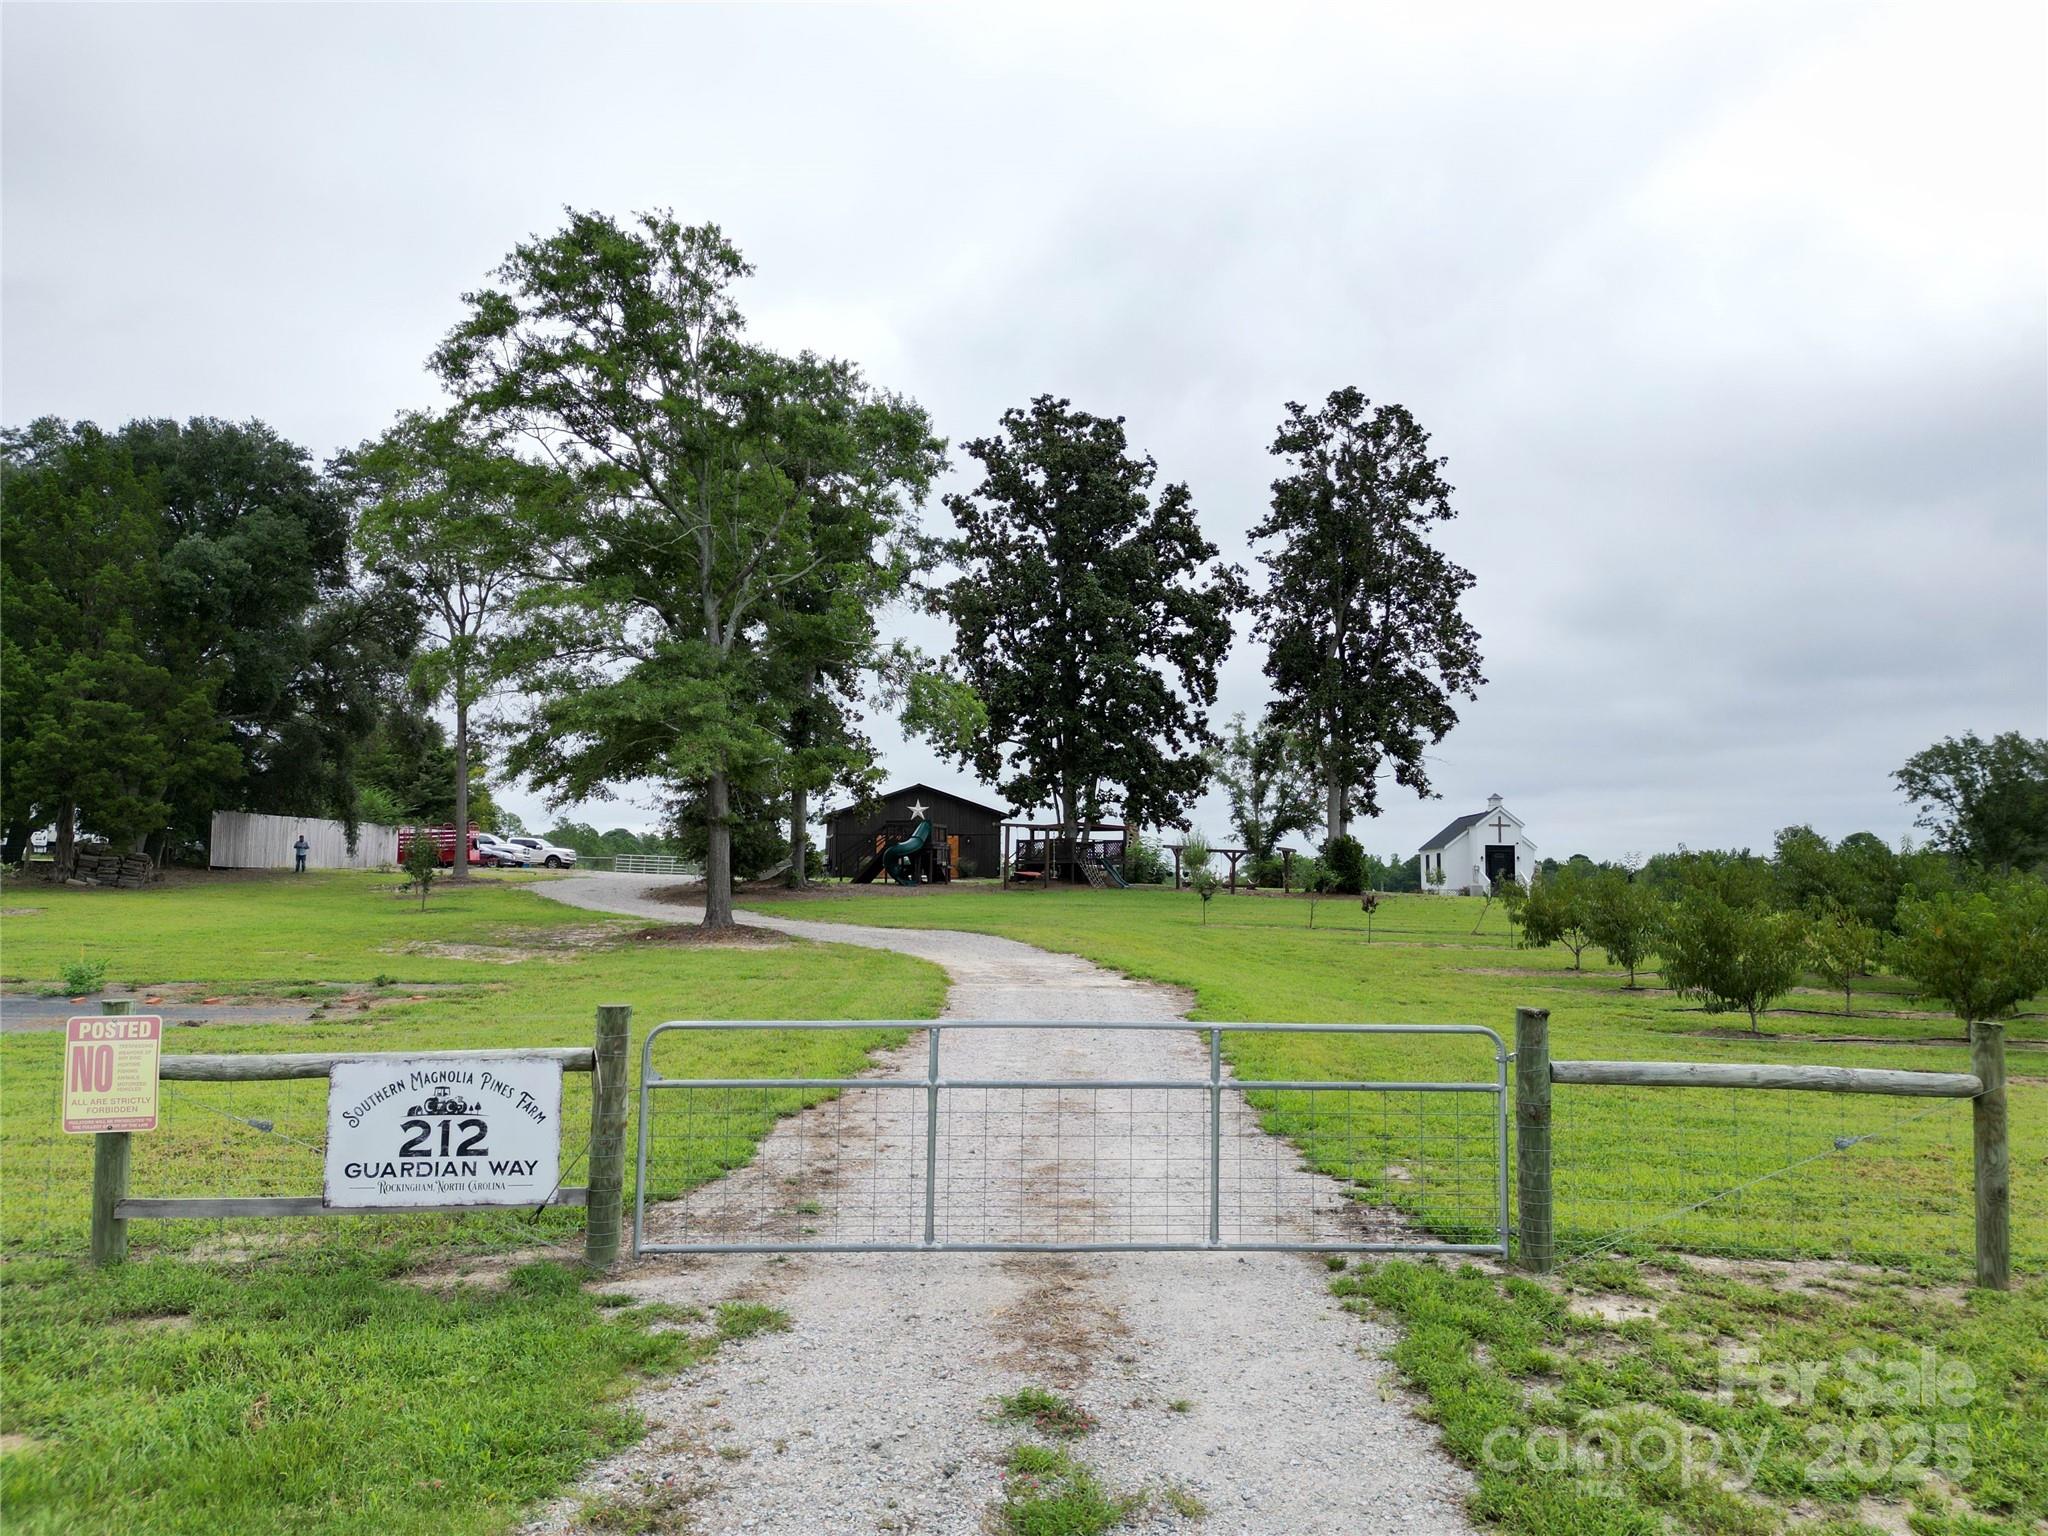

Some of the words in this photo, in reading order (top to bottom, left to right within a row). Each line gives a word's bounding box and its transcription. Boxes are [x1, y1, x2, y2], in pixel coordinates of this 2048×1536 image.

[79, 1021, 151, 1039] POSTED
[71, 1045, 114, 1093] NO
[110, 1097, 151, 1105] STRICTLY
[342, 1080, 406, 1128] SOUTHERN
[410, 1070, 473, 1091] MAGNOLIA
[480, 1072, 515, 1099] PINES
[516, 1091, 547, 1125] FARM
[86, 1106, 138, 1114] FORBIDDEN
[399, 1119, 489, 1157] 212
[344, 1161, 477, 1178] GUARDIAN
[488, 1160, 539, 1176] WAY
[435, 1180, 465, 1193] NORTH
[467, 1180, 506, 1192] CAROLINA
